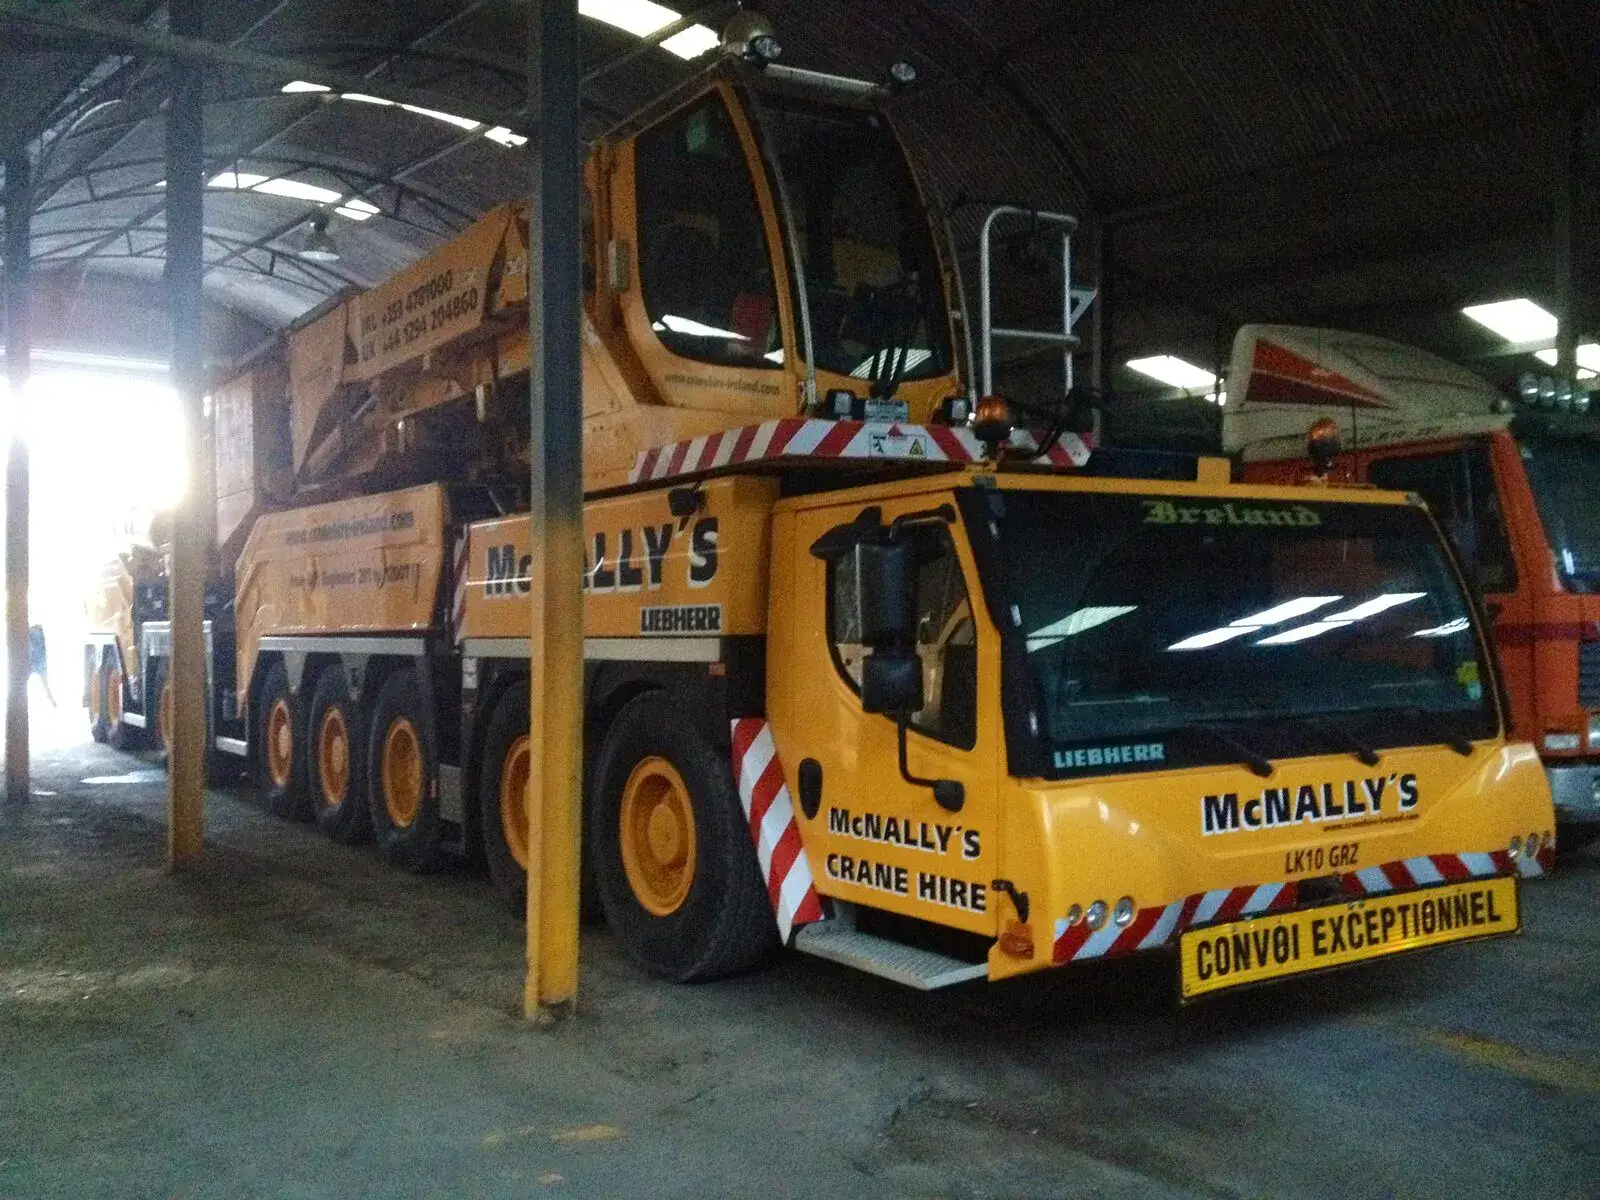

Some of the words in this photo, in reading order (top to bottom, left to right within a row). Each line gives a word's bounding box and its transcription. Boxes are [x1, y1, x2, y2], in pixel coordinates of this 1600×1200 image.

[484, 517, 719, 600] McLLY'S
[640, 604, 722, 635] LIEBHERR
[1053, 742, 1165, 769] LIEBHERR
[1202, 773, 1419, 837] McNALLY'S
[828, 807, 981, 860] McNALLY'S
[1284, 848, 1323, 874] LK10
[1328, 843, 1360, 868] GRZ
[825, 853, 909, 896] CRANE
[917, 872, 987, 912] HIRE
[1197, 922, 1299, 982] CONVOI
[1312, 889, 1501, 958] EXCEPTIONNEL
